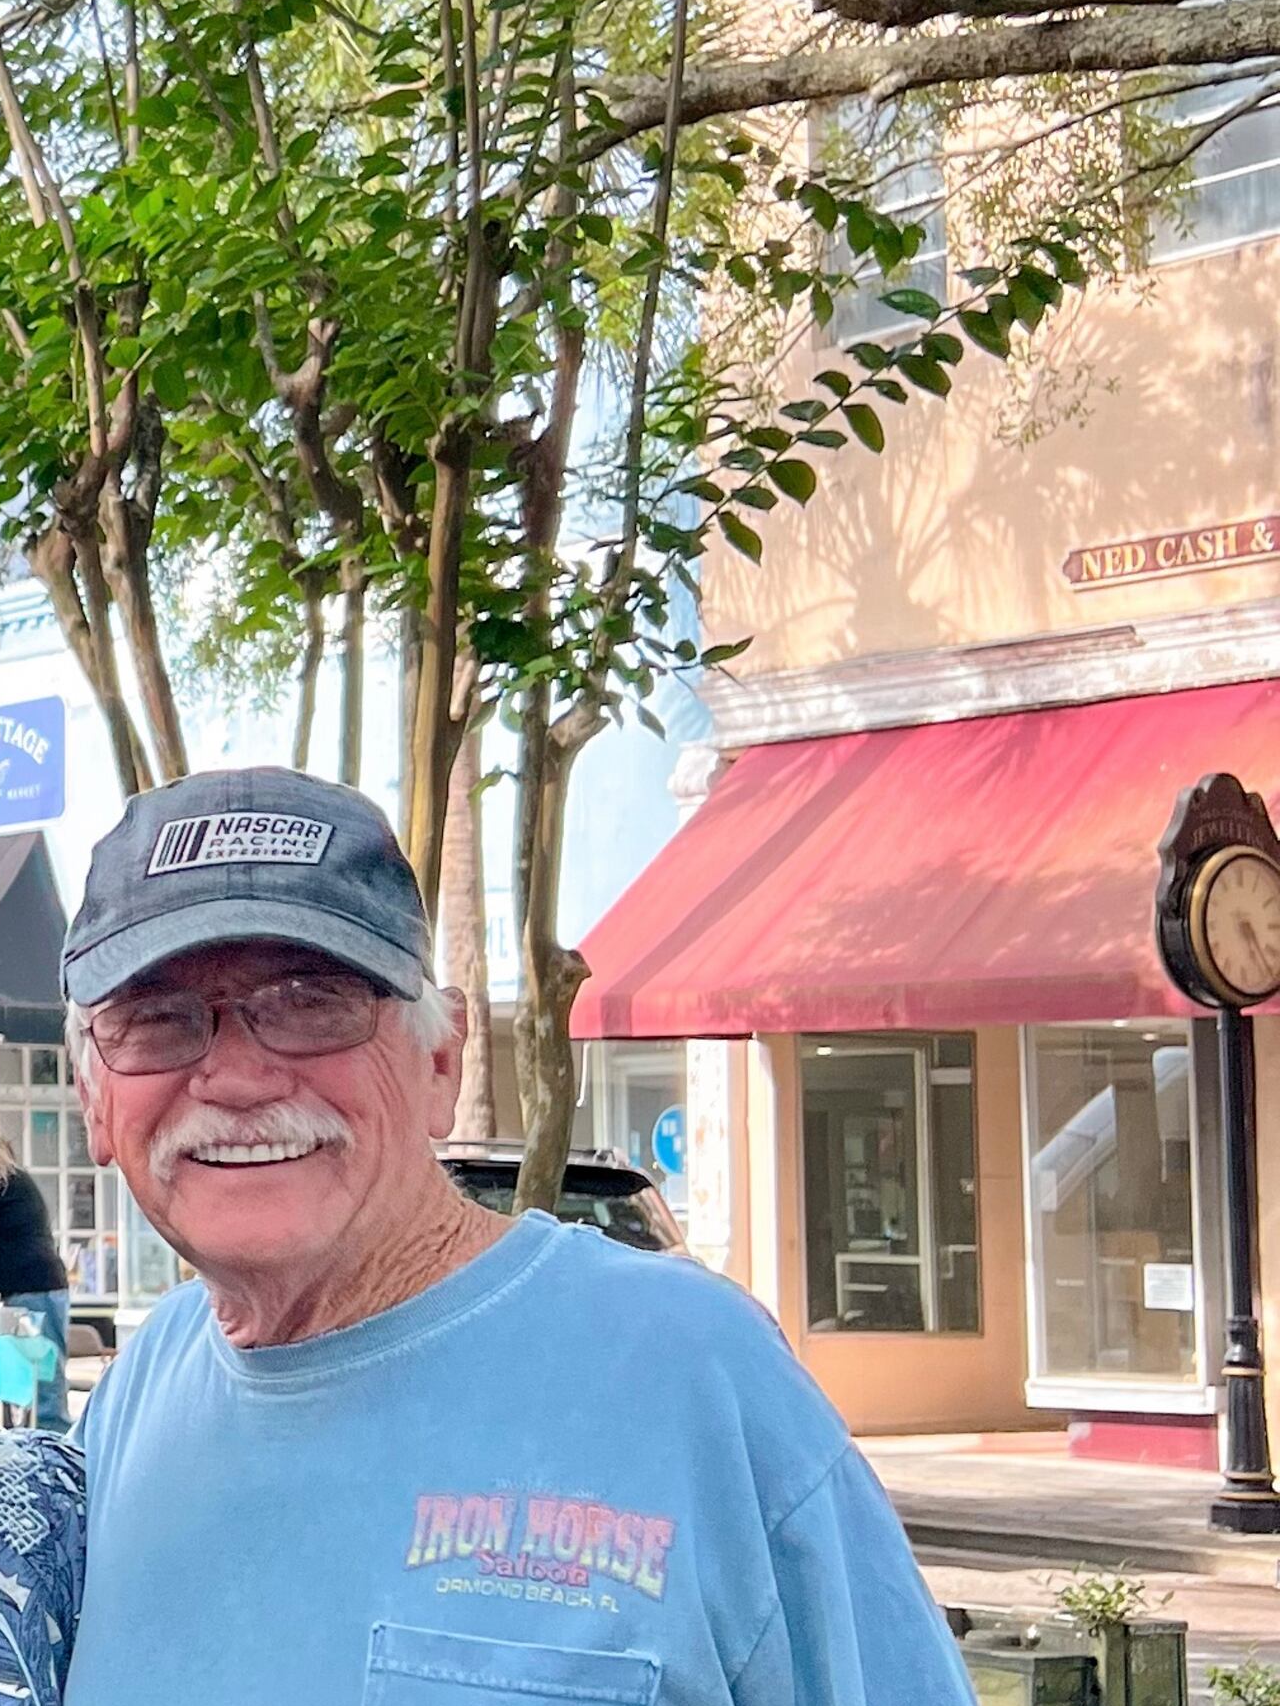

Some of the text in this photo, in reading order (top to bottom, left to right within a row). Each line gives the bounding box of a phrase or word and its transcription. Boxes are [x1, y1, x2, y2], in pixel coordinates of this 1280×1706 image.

[1080, 521, 1275, 581] NED CASH &
[209, 837, 318, 850] RACING
[215, 816, 323, 839] NASCAR
[205, 848, 315, 861] EXPERIENCE
[404, 1493, 677, 1602] IRON HORSE
[477, 1549, 590, 1588] Saloon
[435, 1577, 523, 1600] ORMOND
[599, 1594, 620, 1614] FL
